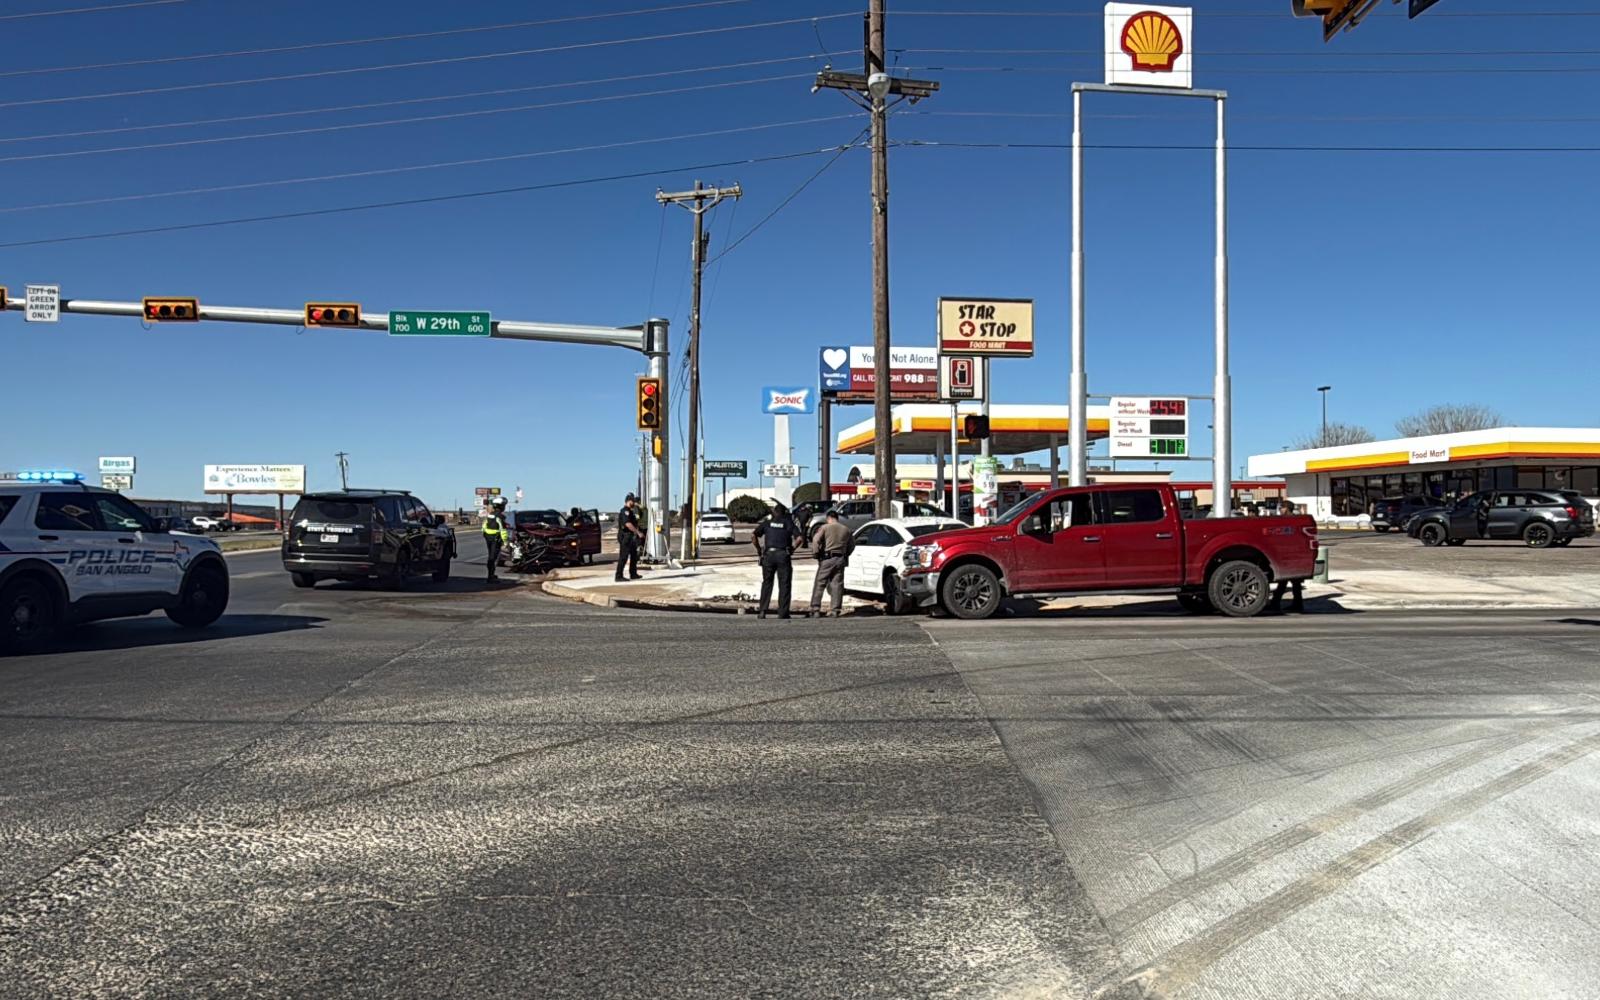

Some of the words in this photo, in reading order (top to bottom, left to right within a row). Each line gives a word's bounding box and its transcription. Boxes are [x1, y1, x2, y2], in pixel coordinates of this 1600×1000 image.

[958, 305, 995, 320] STAR
[416, 318, 427, 330] W
[430, 317, 461, 330] 29th
[471, 315, 480, 323] St
[395, 324, 410, 332] 700
[467, 324, 484, 333] 600
[979, 322, 1016, 337] STOP
[969, 341, 987, 349] FOOD
[891, 353, 907, 363] Not
[909, 353, 937, 364] Alone.
[904, 373, 924, 384] 988
[774, 396, 803, 404] SONIC
[1412, 450, 1428, 459] Food
[1429, 449, 1446, 457] Mart
[67, 550, 156, 564] POLICE
[76, 566, 102, 576] SAN
[104, 564, 152, 575] ANGELO
